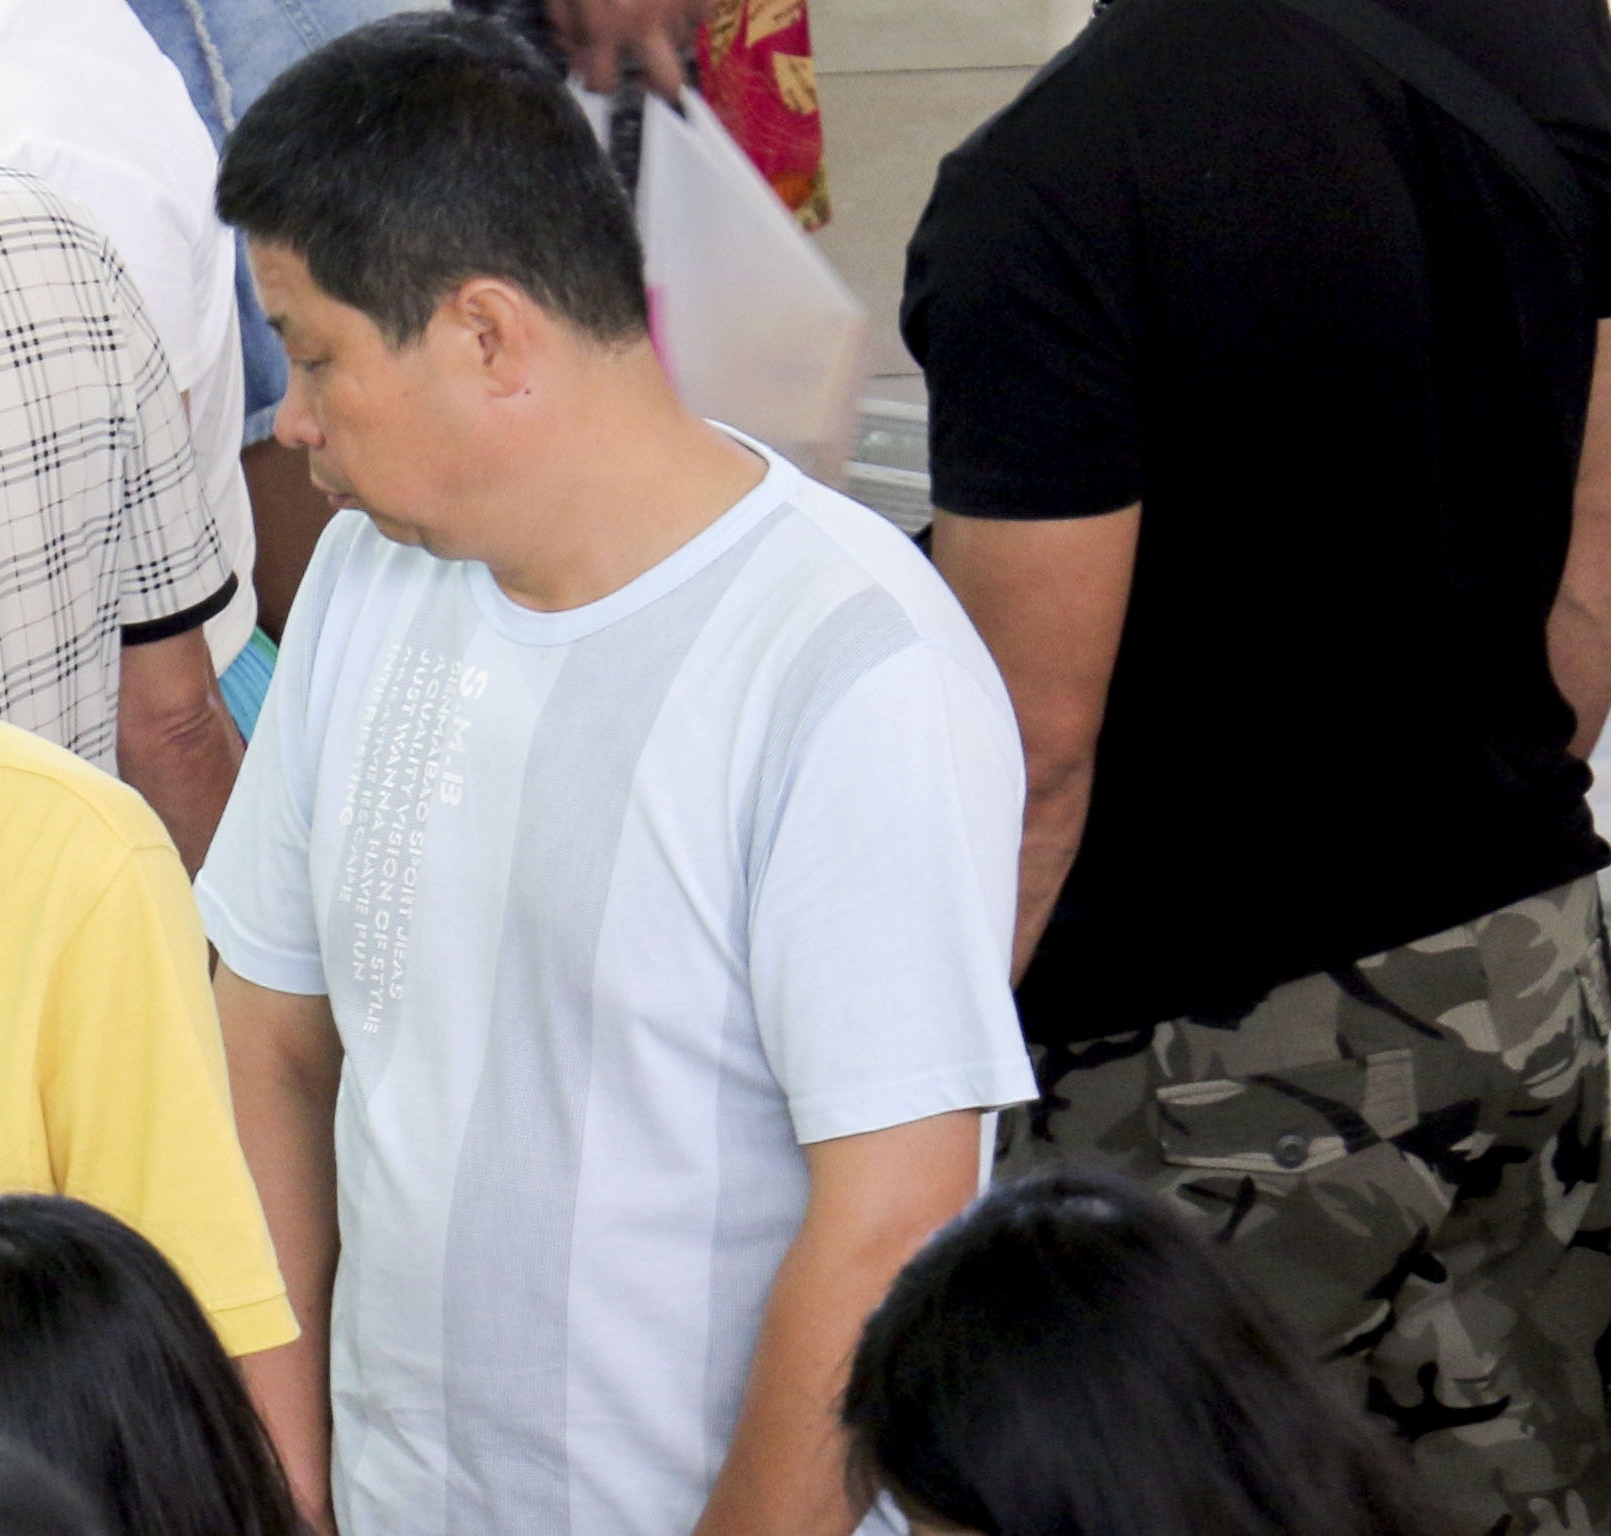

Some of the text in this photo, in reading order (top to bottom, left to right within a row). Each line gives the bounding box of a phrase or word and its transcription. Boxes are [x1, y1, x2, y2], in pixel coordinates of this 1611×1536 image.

[401, 678, 440, 798] QUALITY
[352, 648, 431, 981] JUST WANNA HAVE FUN
[378, 803, 411, 902] VISION
[373, 910, 390, 951] OF
[363, 956, 385, 1034] STYLE
